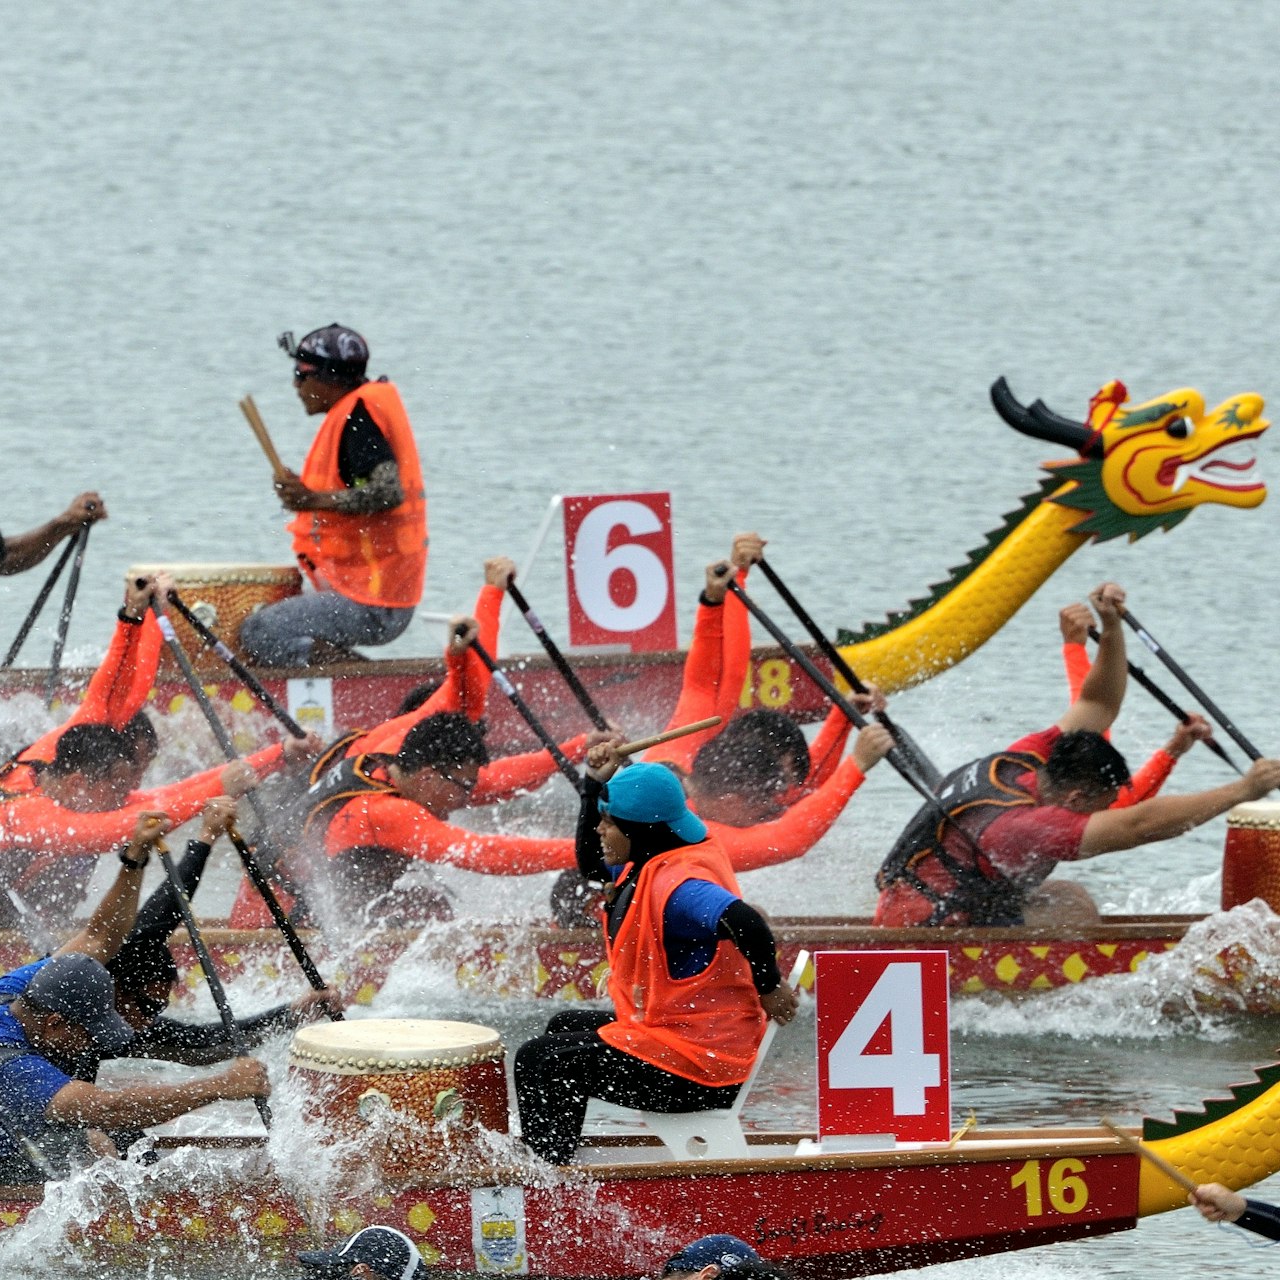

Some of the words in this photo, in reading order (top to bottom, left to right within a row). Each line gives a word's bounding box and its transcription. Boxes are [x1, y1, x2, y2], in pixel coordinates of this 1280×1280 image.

[573, 500, 668, 632] 6
[828, 962, 941, 1116] 4
[1011, 1158, 1089, 1217] 16
